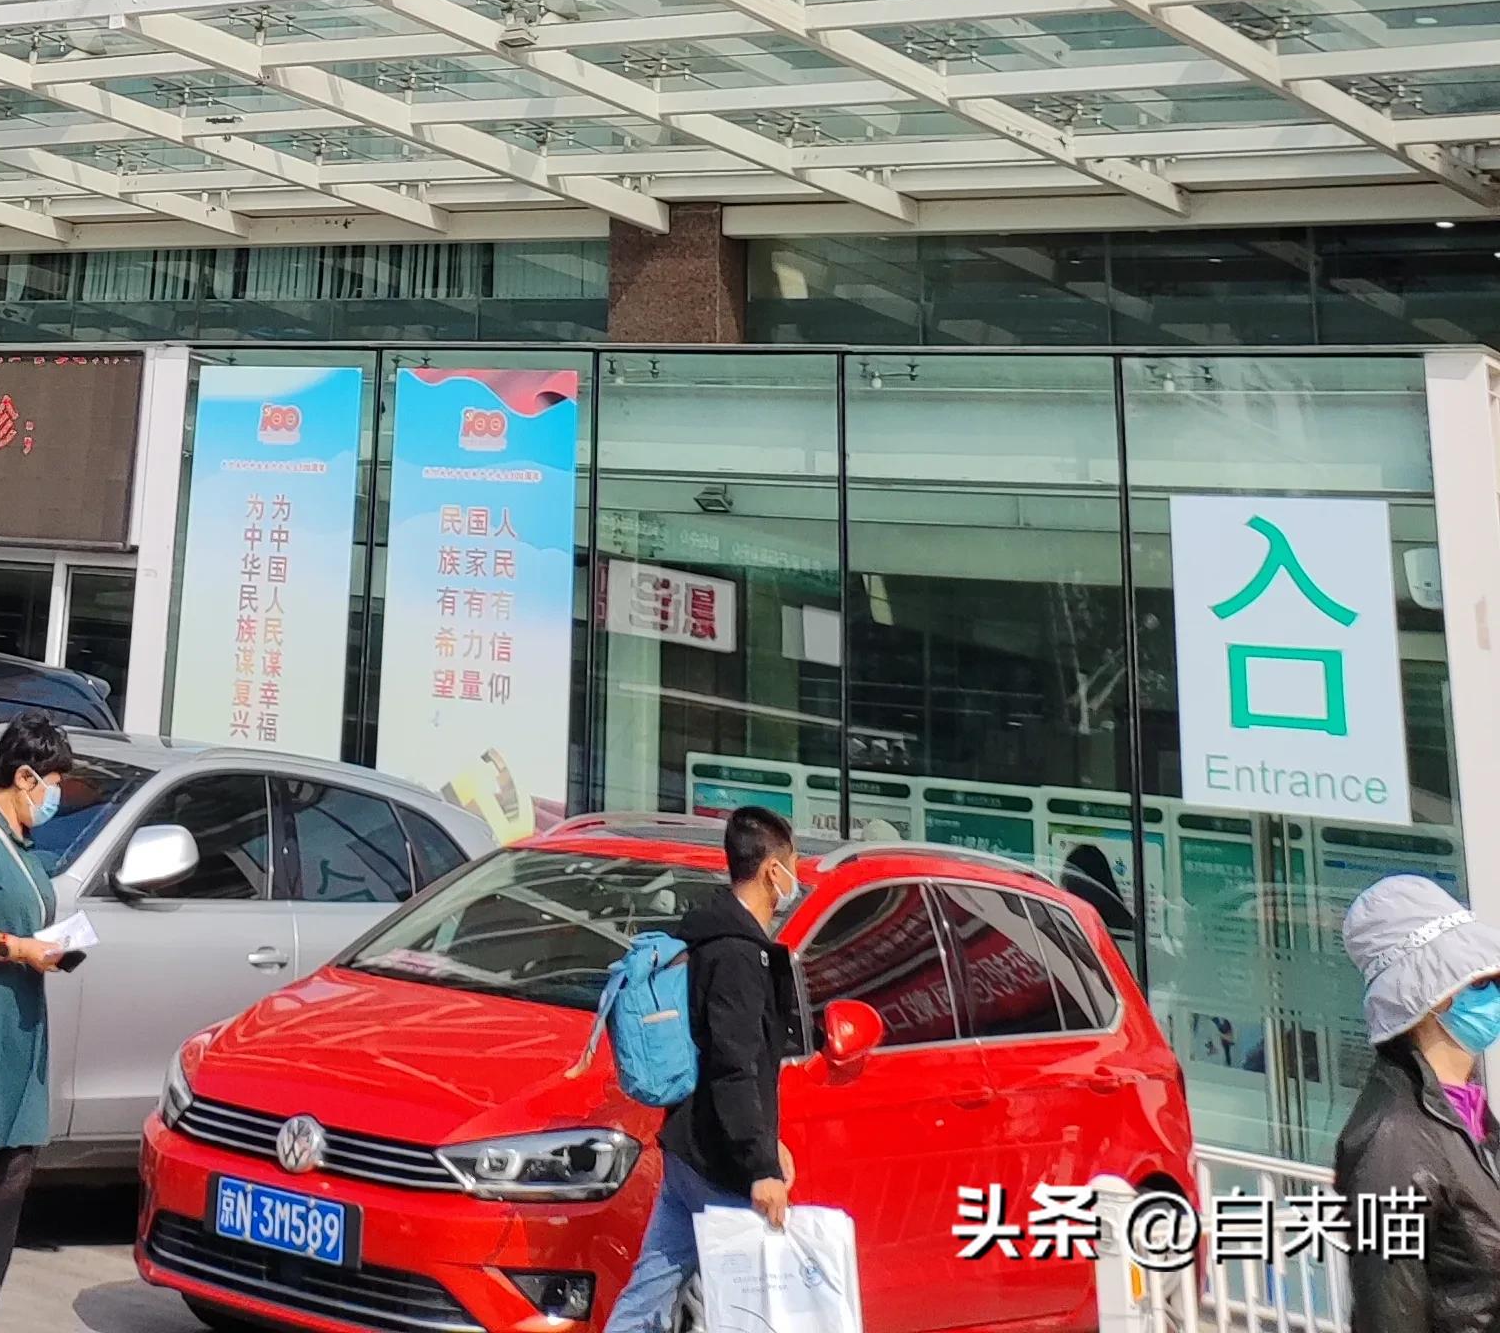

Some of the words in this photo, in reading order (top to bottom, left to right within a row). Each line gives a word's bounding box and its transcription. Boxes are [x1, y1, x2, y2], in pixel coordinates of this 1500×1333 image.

[229, 492, 264, 739] 为中华民族谋复兴
[256, 494, 291, 742] 为中国人民谋幸福
[431, 506, 461, 700] 民族有希望
[459, 508, 488, 702] 国家有力量
[488, 508, 516, 705] 人民有信仰
[1209, 515, 1359, 737] 入口
[1205, 754, 1388, 805] Entrance
